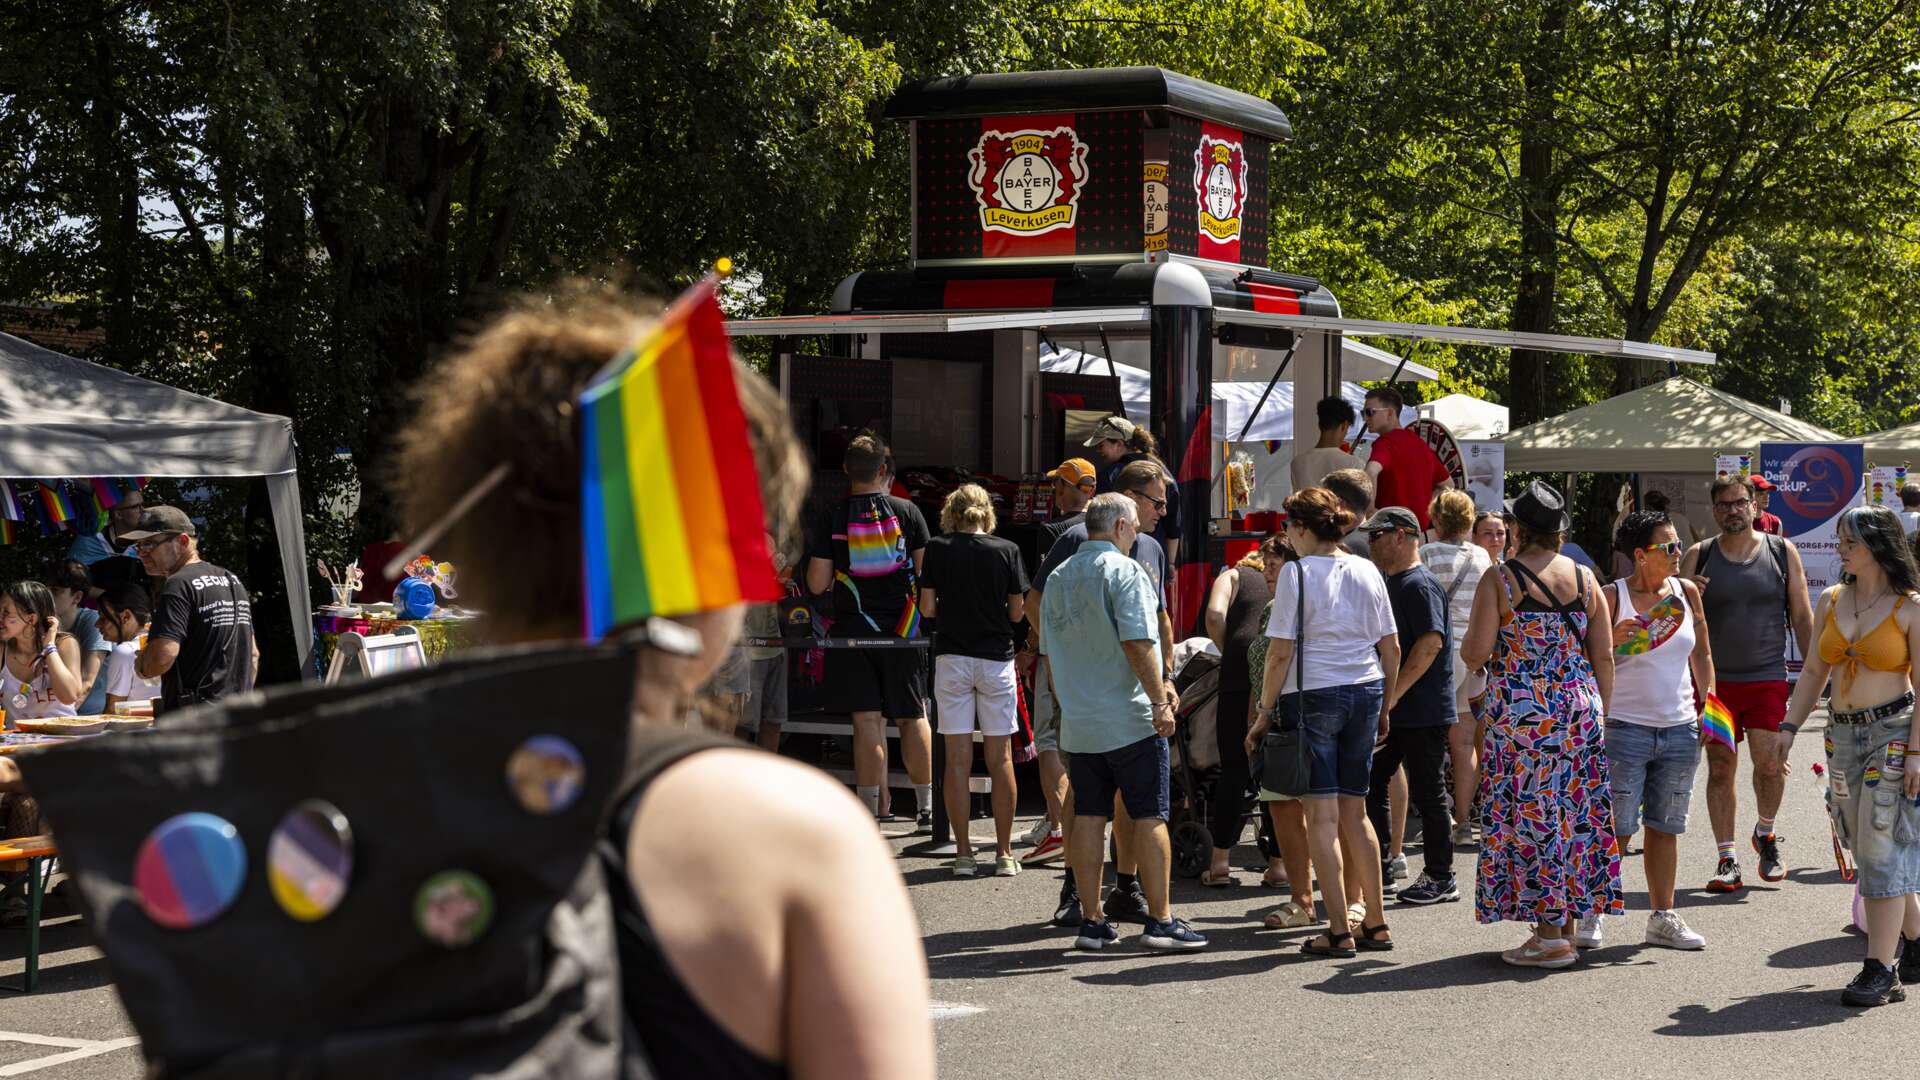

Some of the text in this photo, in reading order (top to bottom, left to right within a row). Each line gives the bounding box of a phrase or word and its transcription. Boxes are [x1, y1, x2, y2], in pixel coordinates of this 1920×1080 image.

[1014, 138, 1040, 151] 1904
[1216, 148, 1228, 160] 1904
[1005, 177, 1052, 189] BAYER
[1023, 157, 1033, 209] BAYER
[1210, 185, 1232, 198] BAYER
[991, 210, 1066, 228] Leverkusen
[1203, 214, 1237, 236] Leverkusen
[1764, 459, 1778, 467] Wir
[1764, 470, 1790, 481] Dein
[1776, 480, 1811, 492] ckUP.
[1795, 542, 1840, 550] SORGE-PRO
